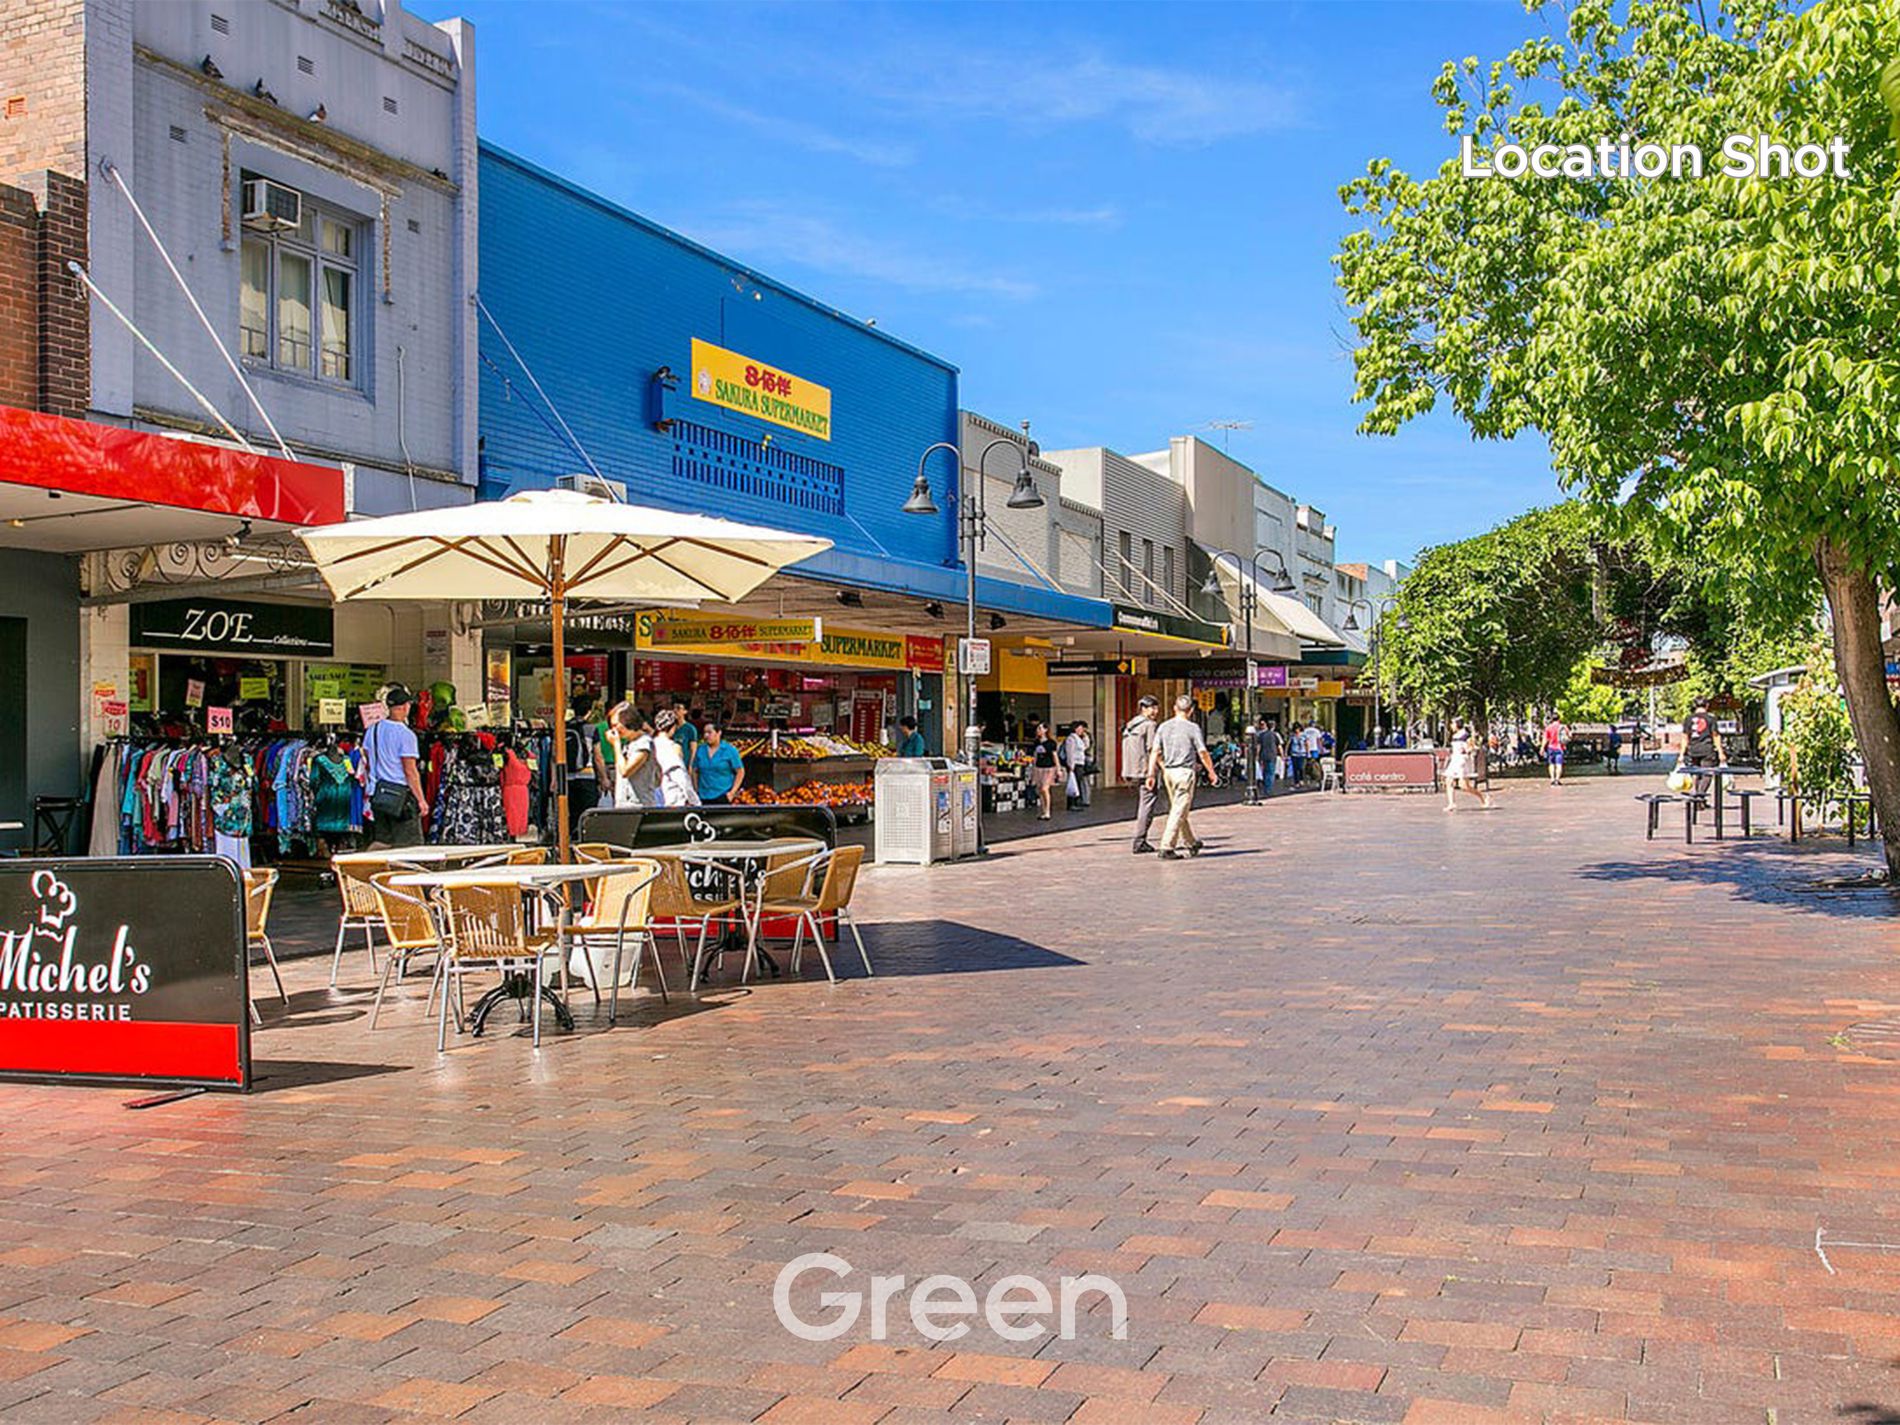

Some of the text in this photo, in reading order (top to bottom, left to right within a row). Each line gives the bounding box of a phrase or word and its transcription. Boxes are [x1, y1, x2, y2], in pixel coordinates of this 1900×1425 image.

[715, 379, 829, 435] SAKURA SUPERMARKET
[180, 608, 253, 642] ZOE
[821, 634, 901, 659] SUPERMARKET
[0, 923, 151, 994] Michel's
[0, 1001, 131, 1021] PATISSERIE
